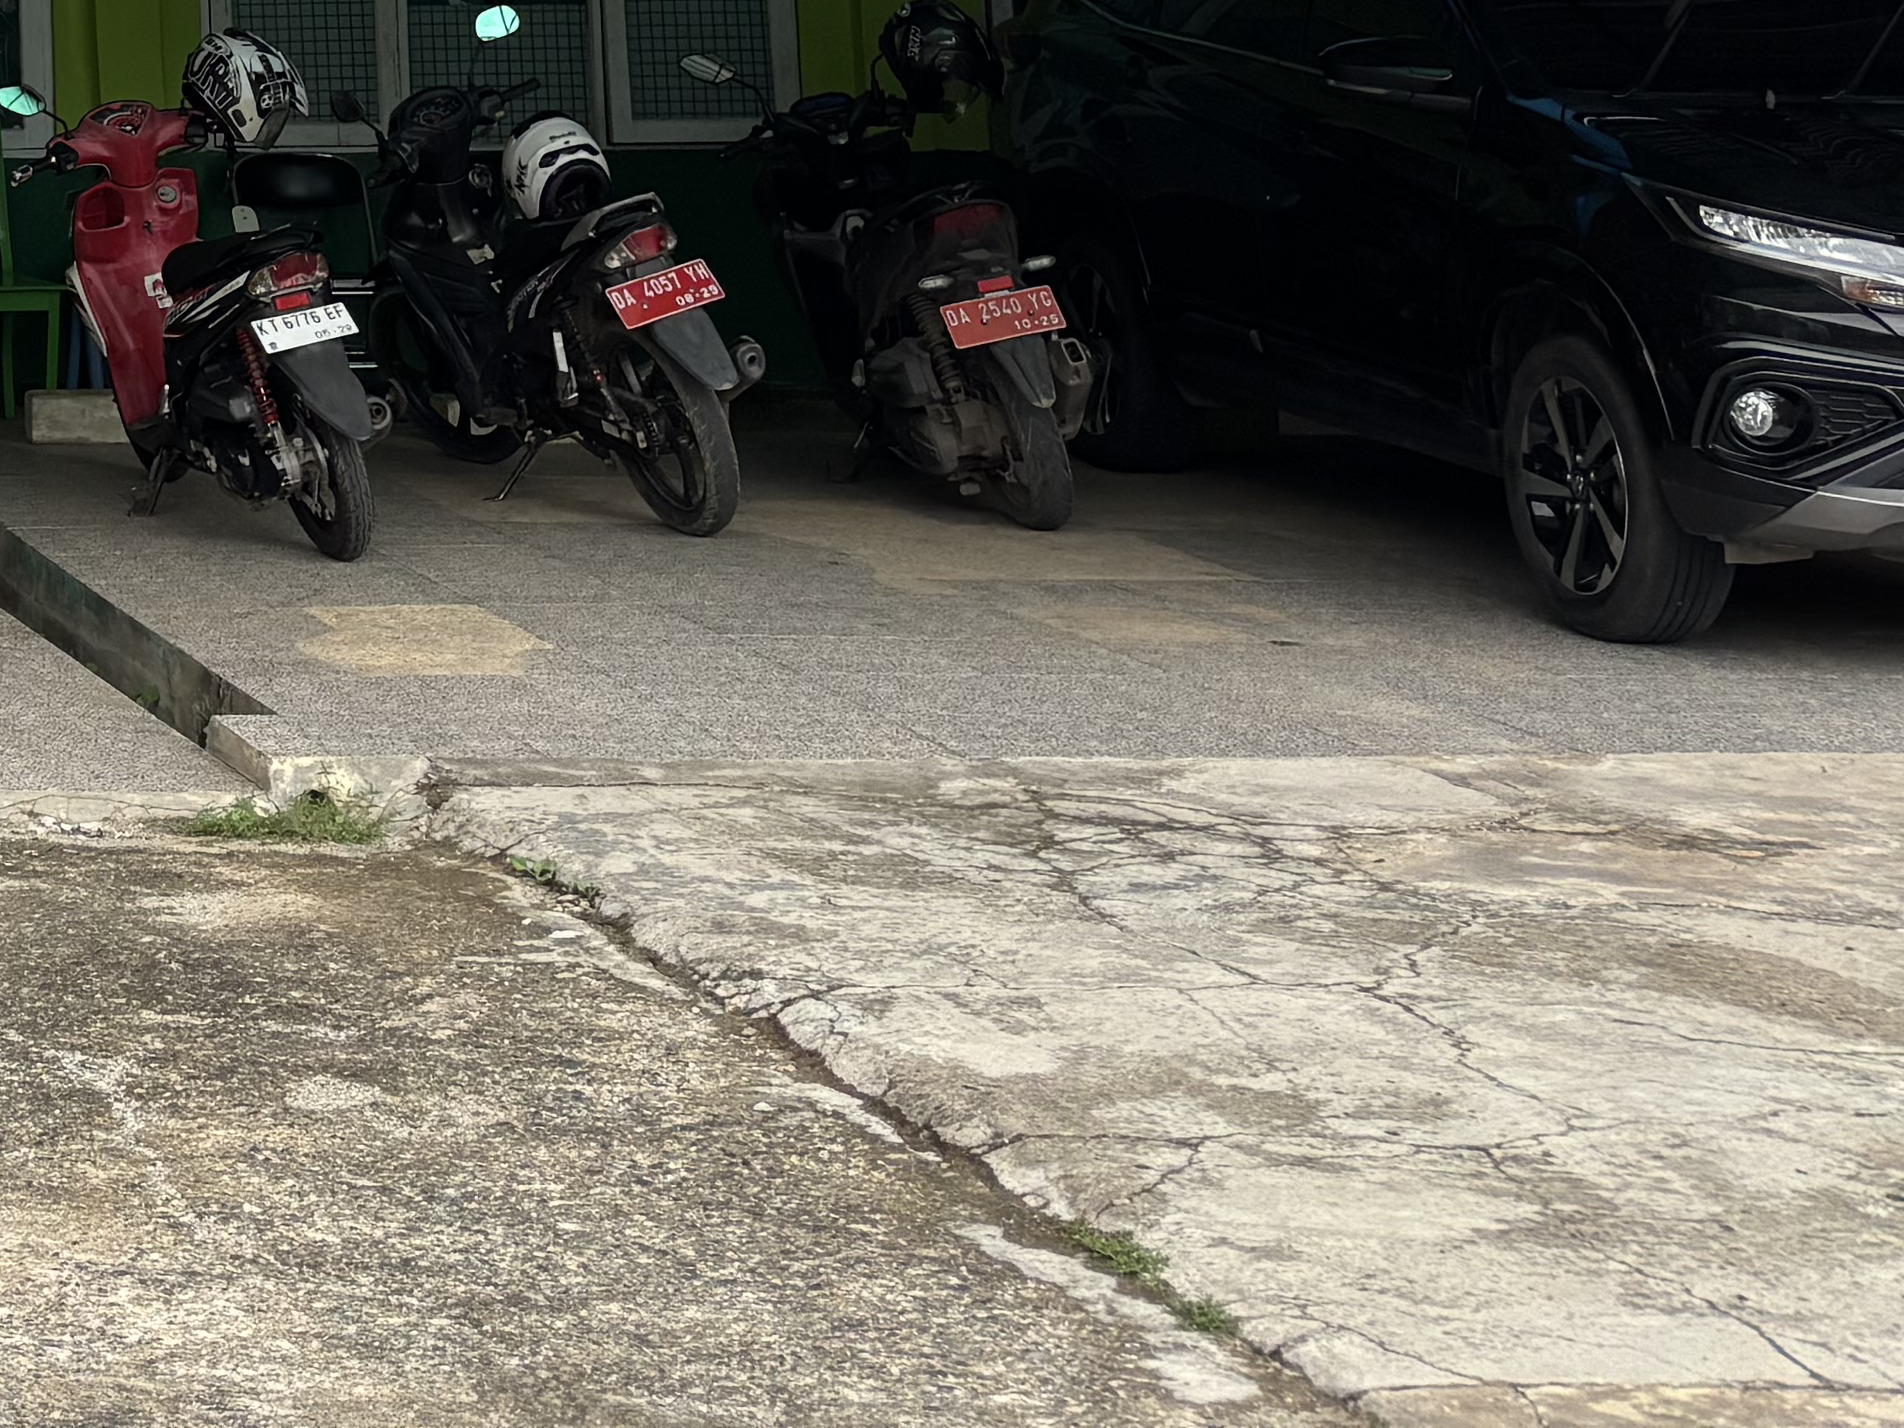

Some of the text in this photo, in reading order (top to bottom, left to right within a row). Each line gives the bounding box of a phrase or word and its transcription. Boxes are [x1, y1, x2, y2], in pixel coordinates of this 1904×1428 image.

[611, 263, 709, 310] DA 4057 YH
[285, 311, 321, 330] 6776
[326, 305, 343, 320] EF
[946, 308, 971, 326] DA
[978, 298, 1022, 319] 2540
